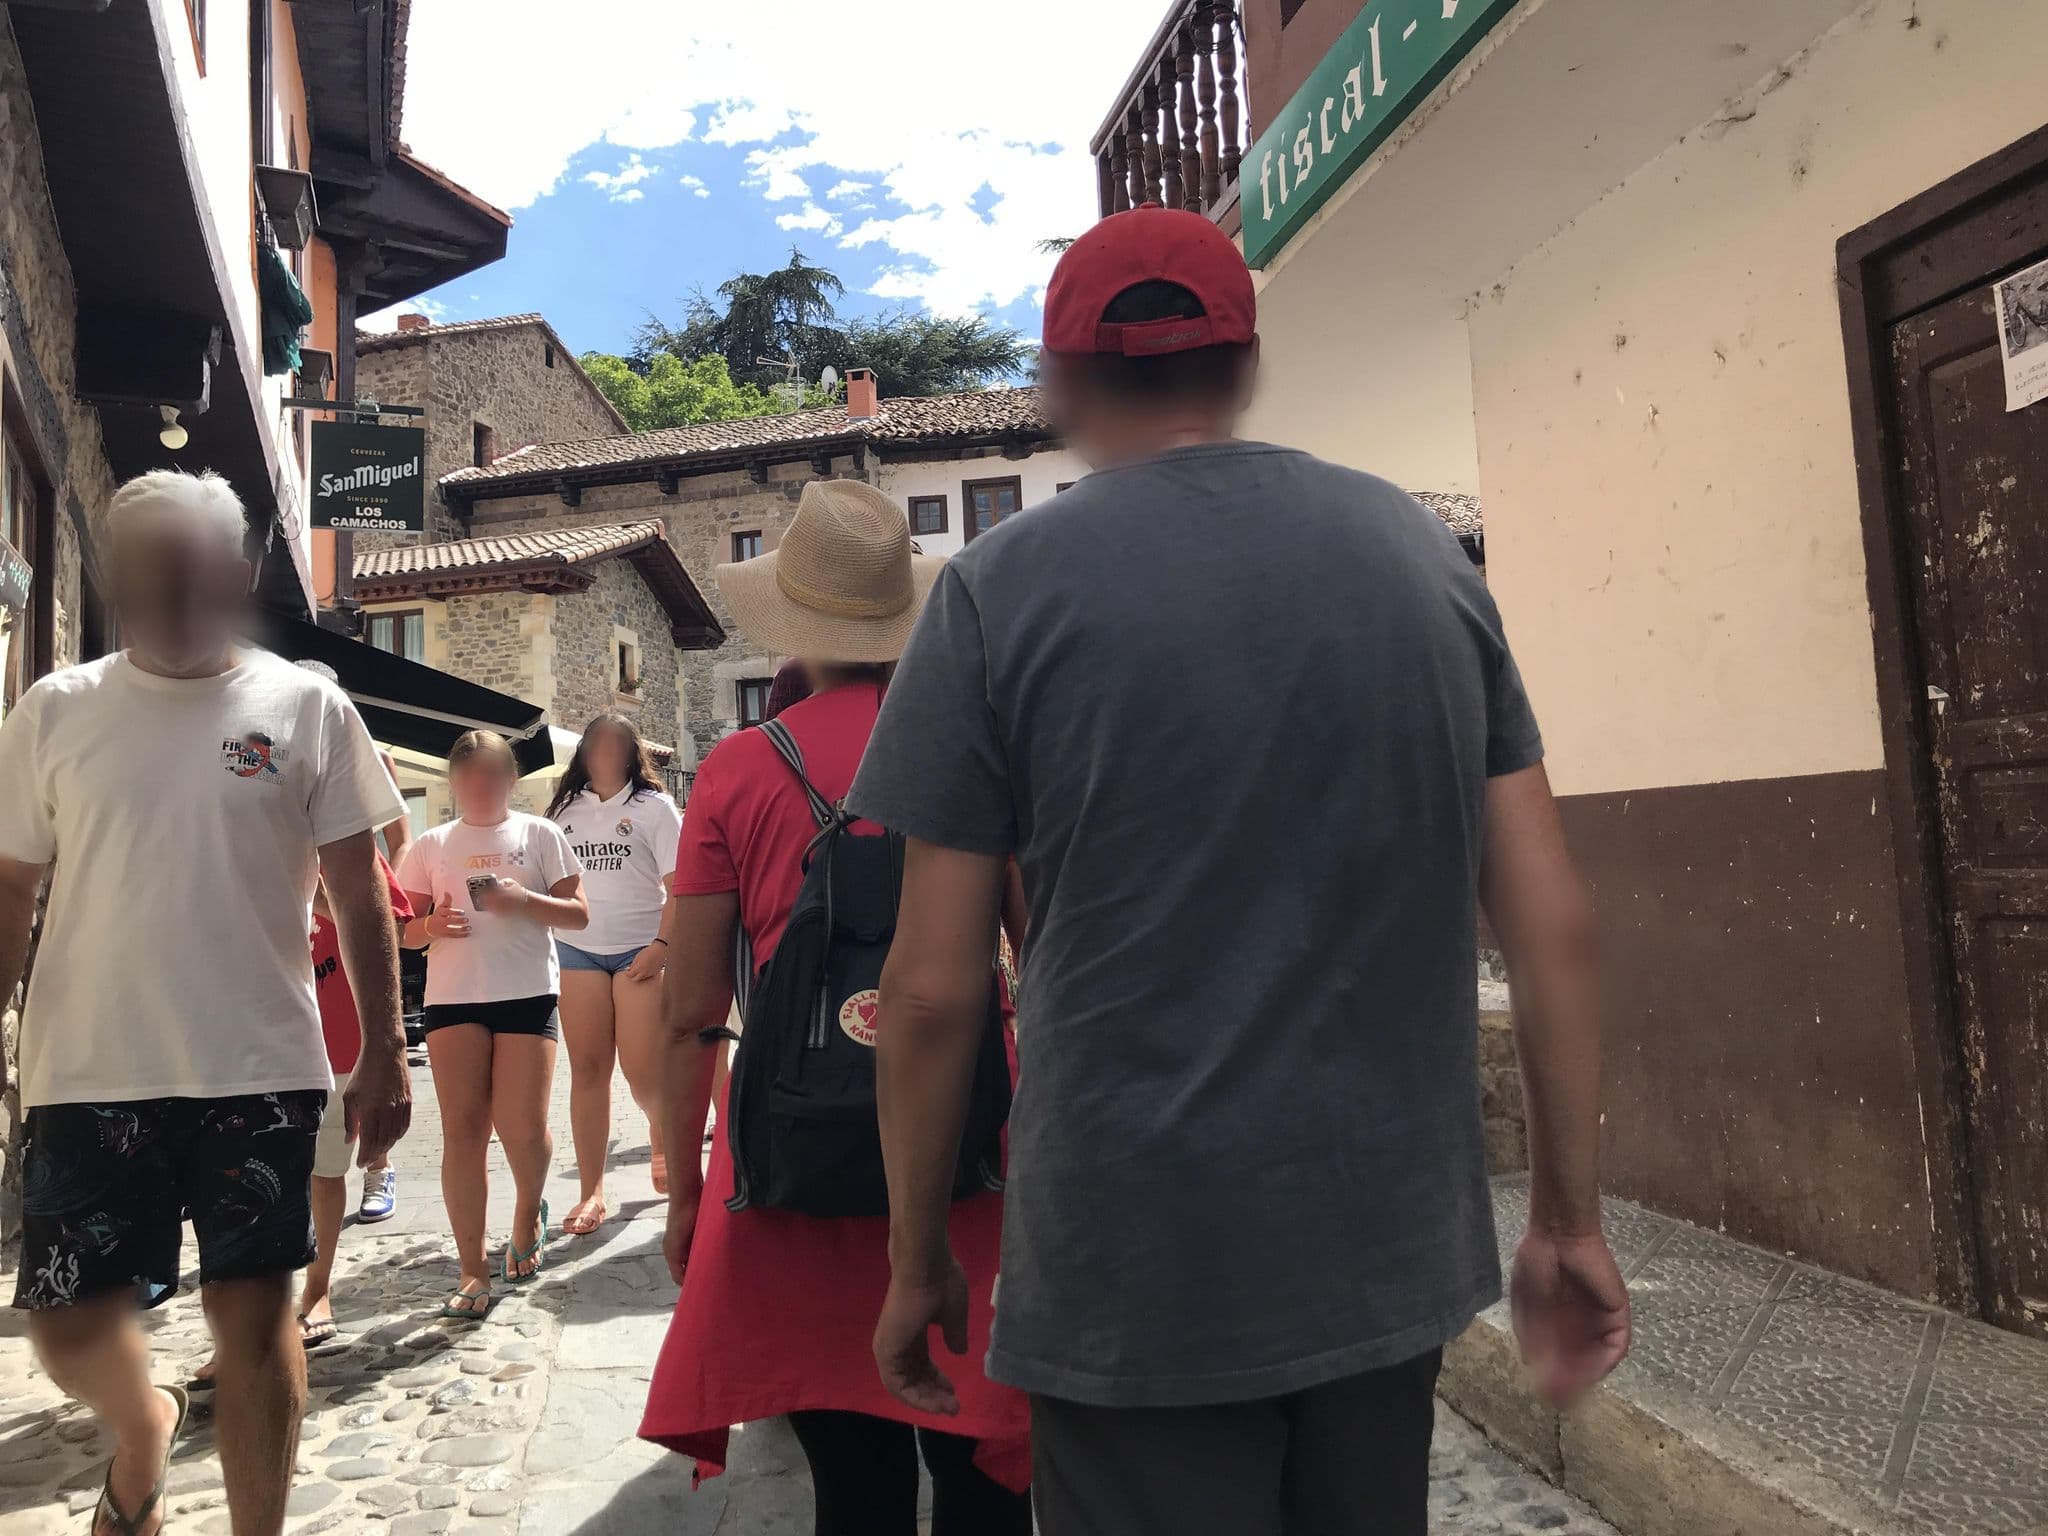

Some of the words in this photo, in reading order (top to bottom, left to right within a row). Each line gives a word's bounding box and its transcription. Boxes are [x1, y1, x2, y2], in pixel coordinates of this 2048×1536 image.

[1259, 13, 1387, 221] fiscal
[356, 506, 382, 517] LOS
[330, 517, 407, 530] CAMACHOS
[572, 840, 632, 858] mirates
[586, 857, 623, 871] BETTER
